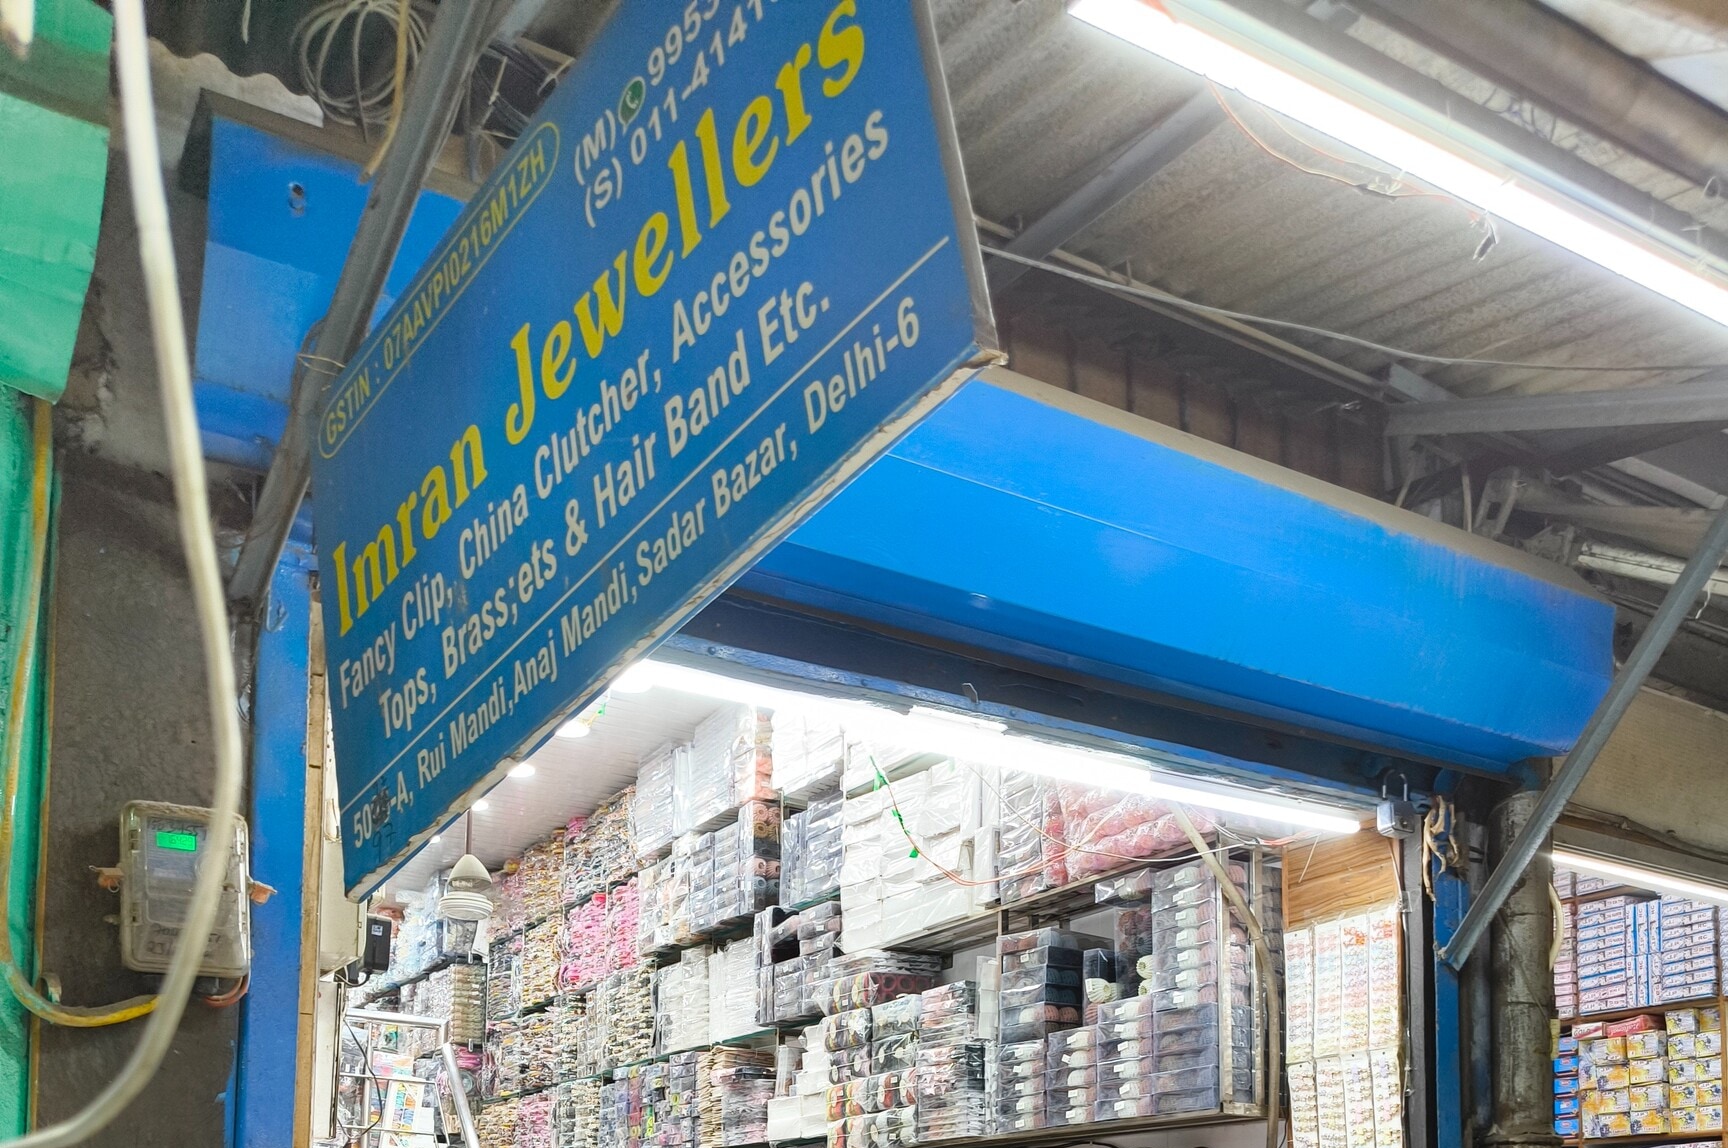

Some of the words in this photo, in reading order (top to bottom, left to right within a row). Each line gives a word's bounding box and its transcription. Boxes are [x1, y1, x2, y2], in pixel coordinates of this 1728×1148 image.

[333, 424, 487, 637] Imran
[505, 0, 865, 445] Jewellers
[574, 109, 617, 186] (M)
[584, 157, 623, 229] (S)
[630, 0, 779, 165] 011-4141
[326, 367, 370, 445] GSTIN
[339, 621, 397, 709] Fancy
[401, 571, 453, 641] Clip,
[458, 484, 530, 580] China
[534, 348, 662, 499] Clutcher,
[672, 109, 889, 364] Accessories
[378, 667, 437, 739] Tops,
[564, 498, 589, 556] &
[593, 432, 657, 528] Hair
[664, 329, 751, 458] Band
[757, 281, 831, 366] Etc.
[416, 732, 447, 789] Rui
[636, 497, 706, 586] Sadar
[711, 421, 798, 519] Bazar,
[803, 296, 920, 435] Delhi-6
